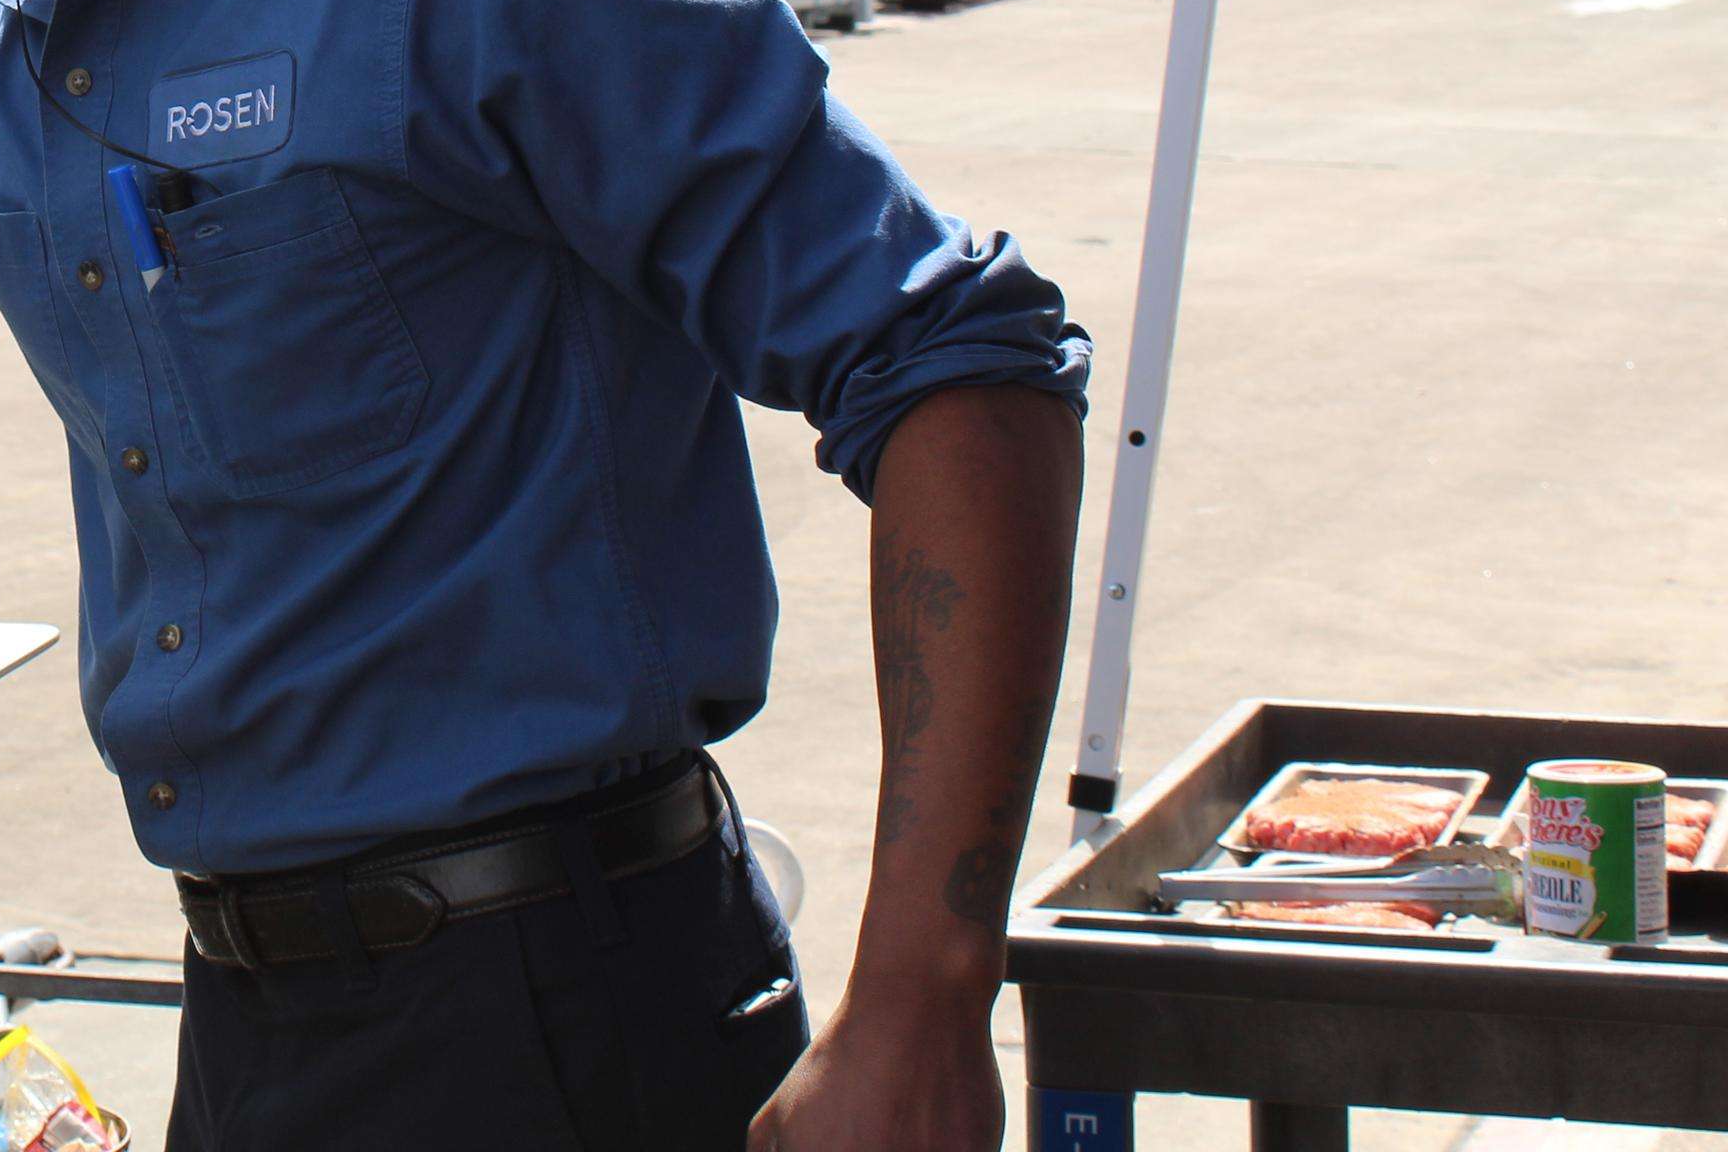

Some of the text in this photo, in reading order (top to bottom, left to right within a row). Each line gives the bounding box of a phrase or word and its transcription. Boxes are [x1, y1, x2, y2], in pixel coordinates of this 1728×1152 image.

[166, 84, 275, 143] ROSEN
[1530, 797, 1581, 821] ony
[1530, 873, 1583, 904] REOLE
